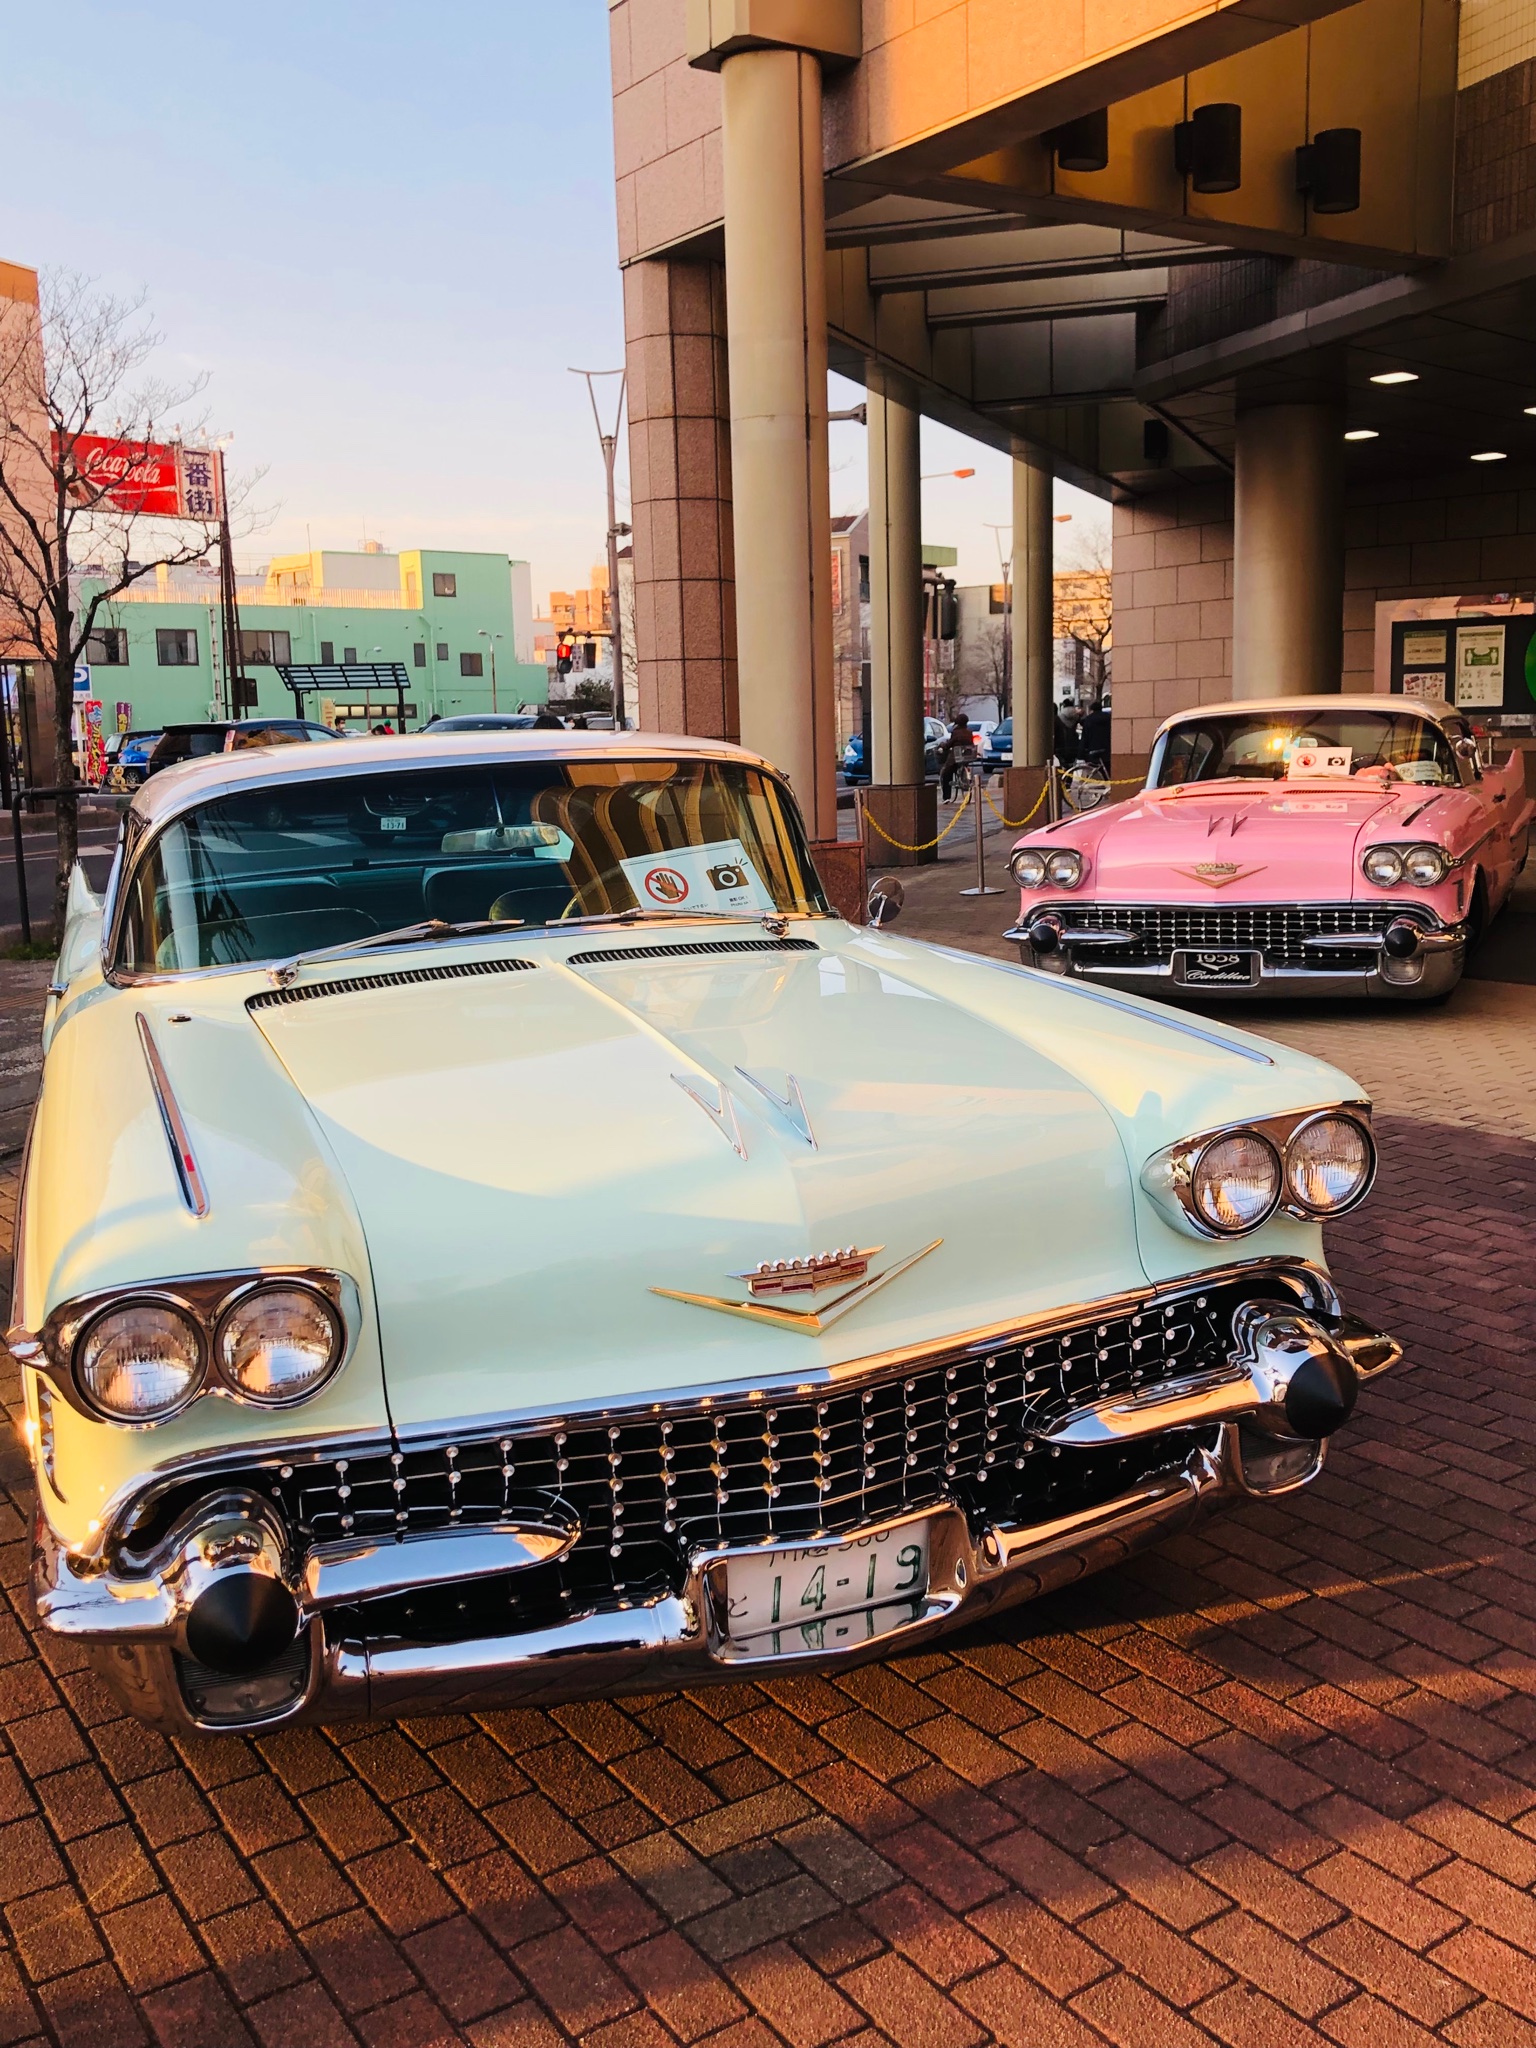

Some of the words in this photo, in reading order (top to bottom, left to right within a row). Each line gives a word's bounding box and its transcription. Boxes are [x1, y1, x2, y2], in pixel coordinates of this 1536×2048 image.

[183, 450, 213, 514] 一番街
[1186, 969, 1251, 980] Cadillac
[1196, 953, 1240, 963] 1958
[771, 1544, 922, 1623] 14-19
